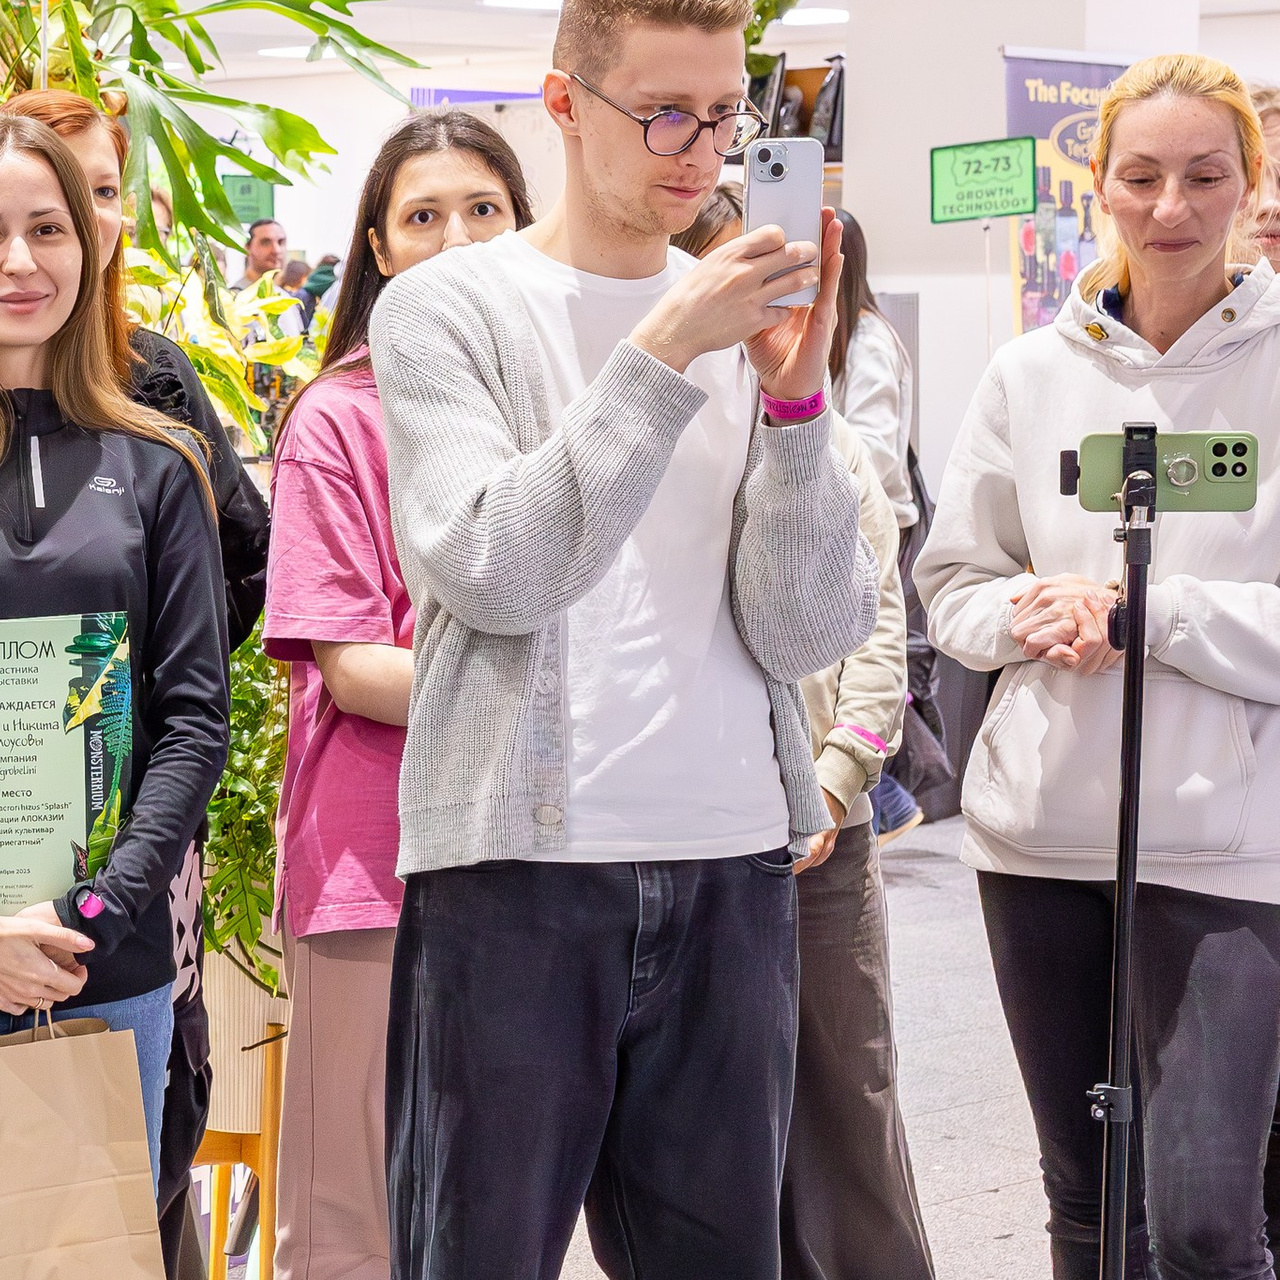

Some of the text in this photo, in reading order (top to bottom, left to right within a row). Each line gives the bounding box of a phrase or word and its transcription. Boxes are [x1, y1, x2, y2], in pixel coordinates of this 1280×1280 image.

[1024, 78, 1106, 106] The Focu
[962, 155, 1011, 176] 72-73
[956, 186, 1014, 201] GROWTH
[942, 197, 1029, 215] TECHNOLOGY
[2, 723, 10, 732] и
[12, 718, 60, 732] Никита
[89, 729, 104, 811] MONSTERRIUM
[1, 789, 33, 798] место
[20, 814, 65, 823] АЛОКАЗИИ
[14, 826, 55, 836] культивар
